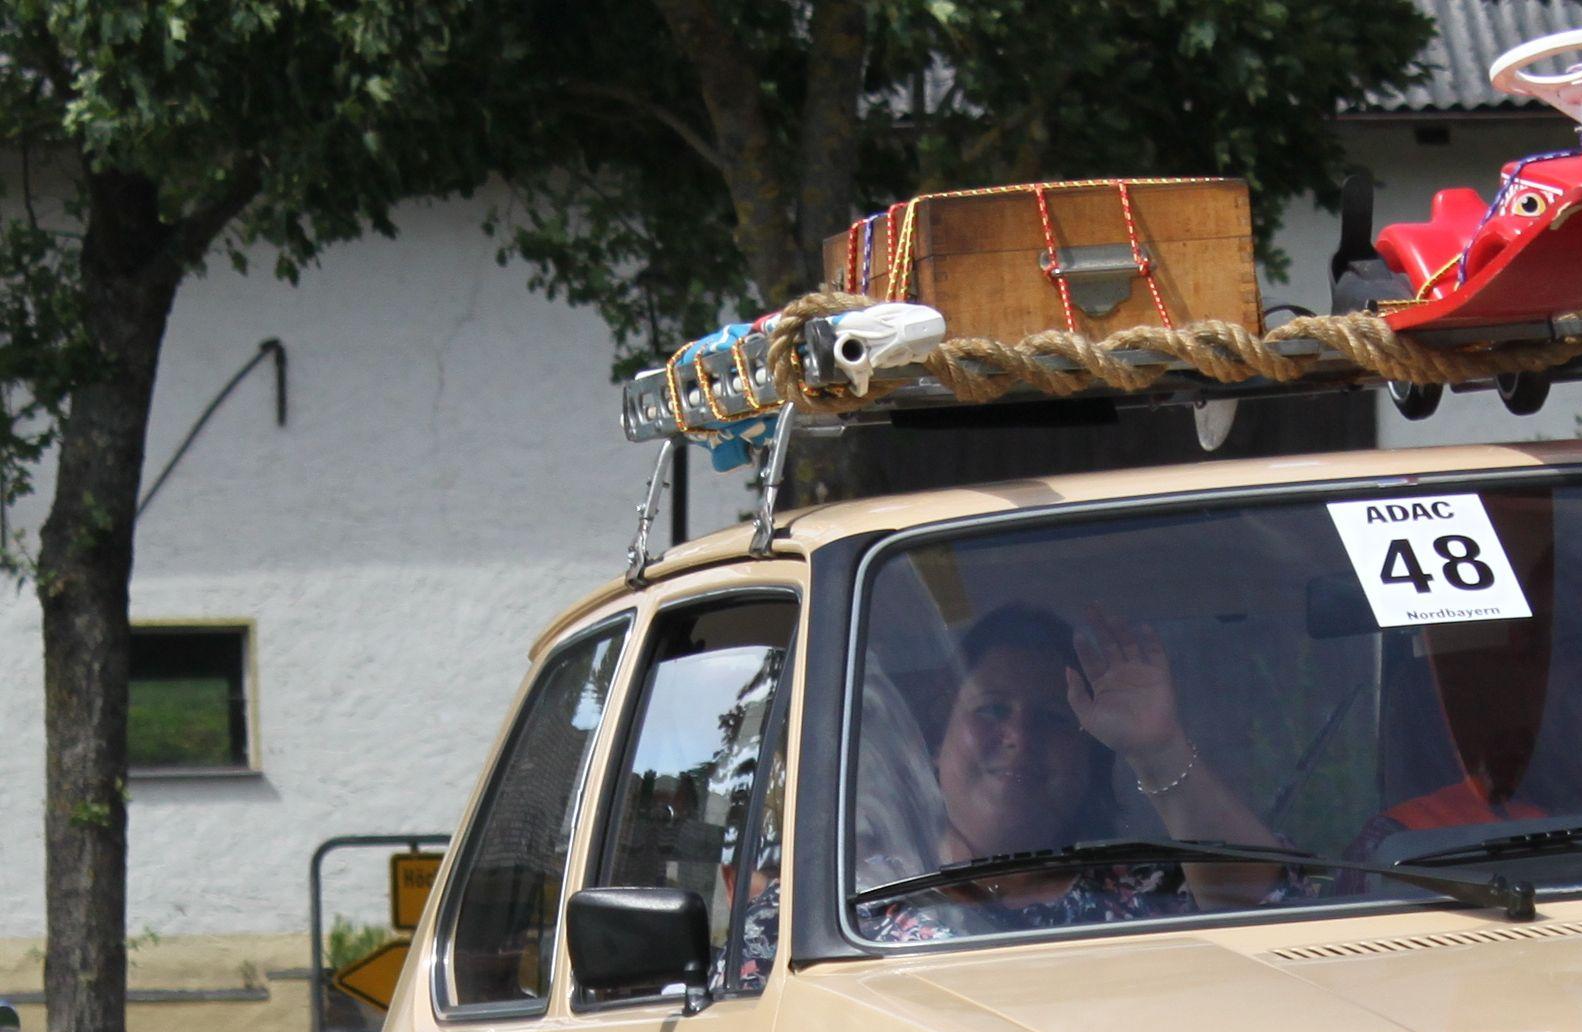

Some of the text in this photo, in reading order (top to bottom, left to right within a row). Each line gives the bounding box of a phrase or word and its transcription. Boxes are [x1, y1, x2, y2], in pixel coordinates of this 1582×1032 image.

[1367, 501, 1455, 524] ADAC
[1380, 535, 1495, 594] 48
[1406, 606, 1501, 621] Nordbayern
